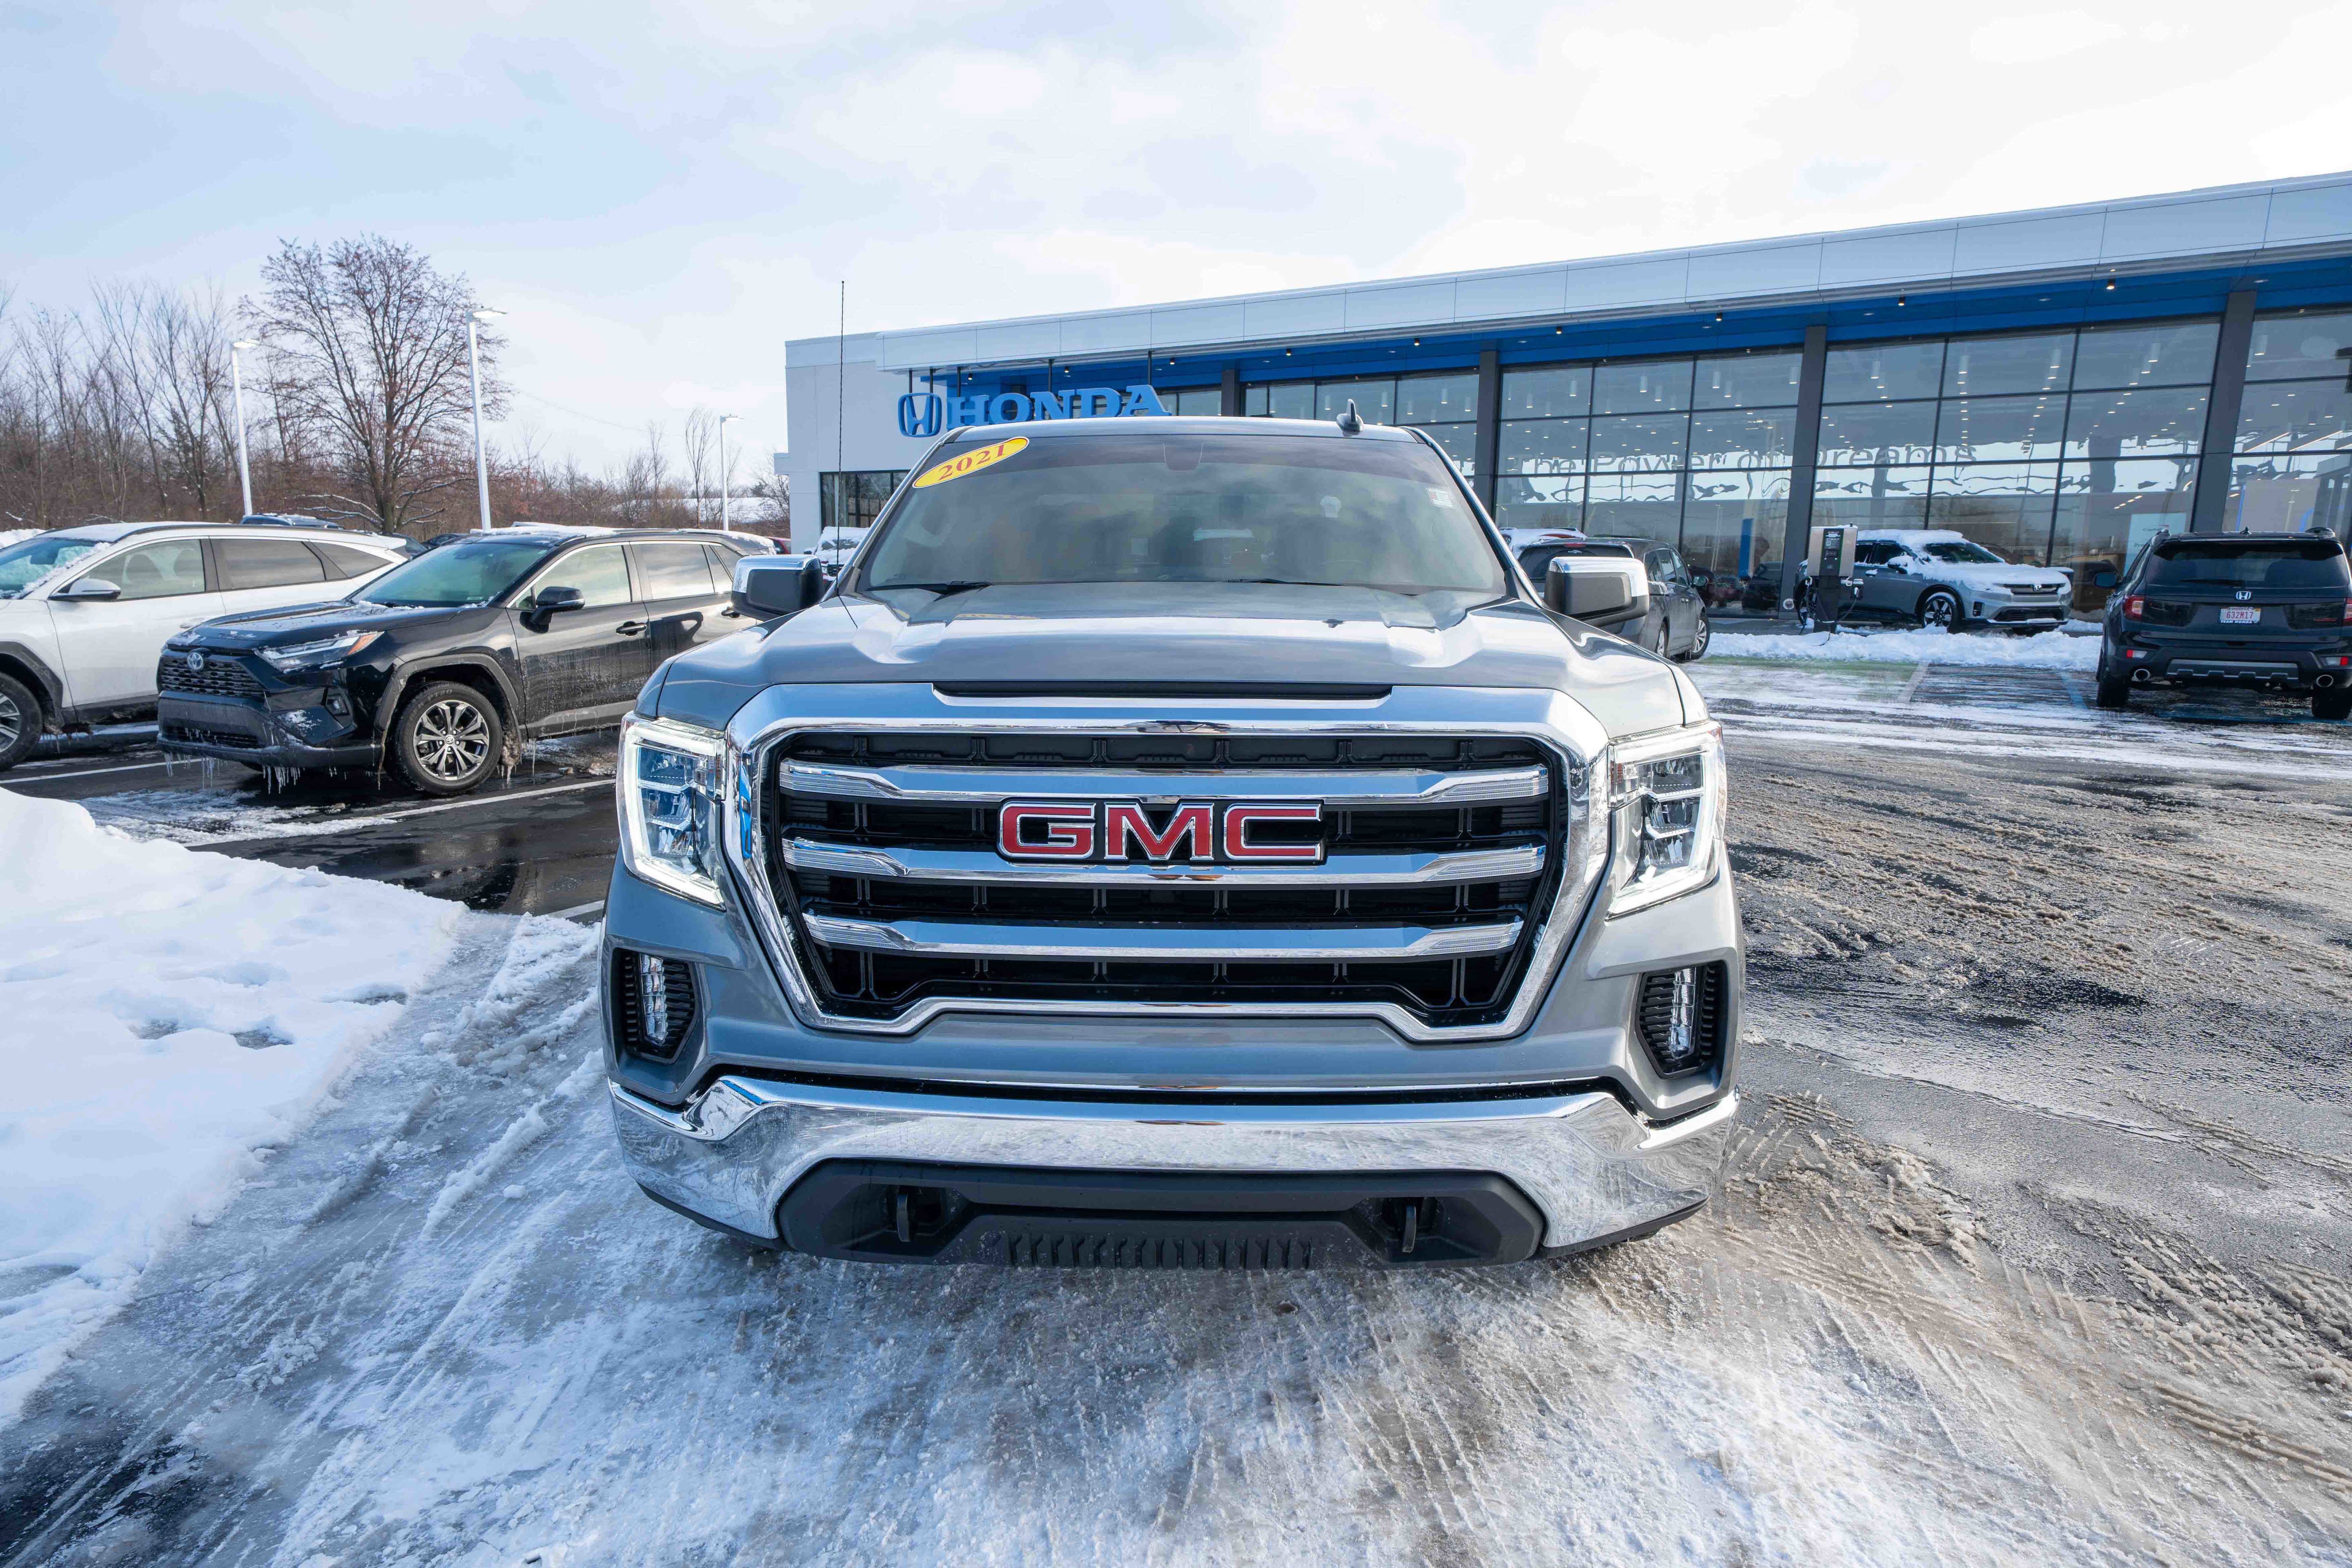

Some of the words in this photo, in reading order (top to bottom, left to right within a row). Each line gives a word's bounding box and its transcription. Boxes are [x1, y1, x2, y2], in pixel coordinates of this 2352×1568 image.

[947, 385, 1172, 430] HONDA
[938, 444, 1004, 481] 2021
[998, 801, 1322, 860] GMC
